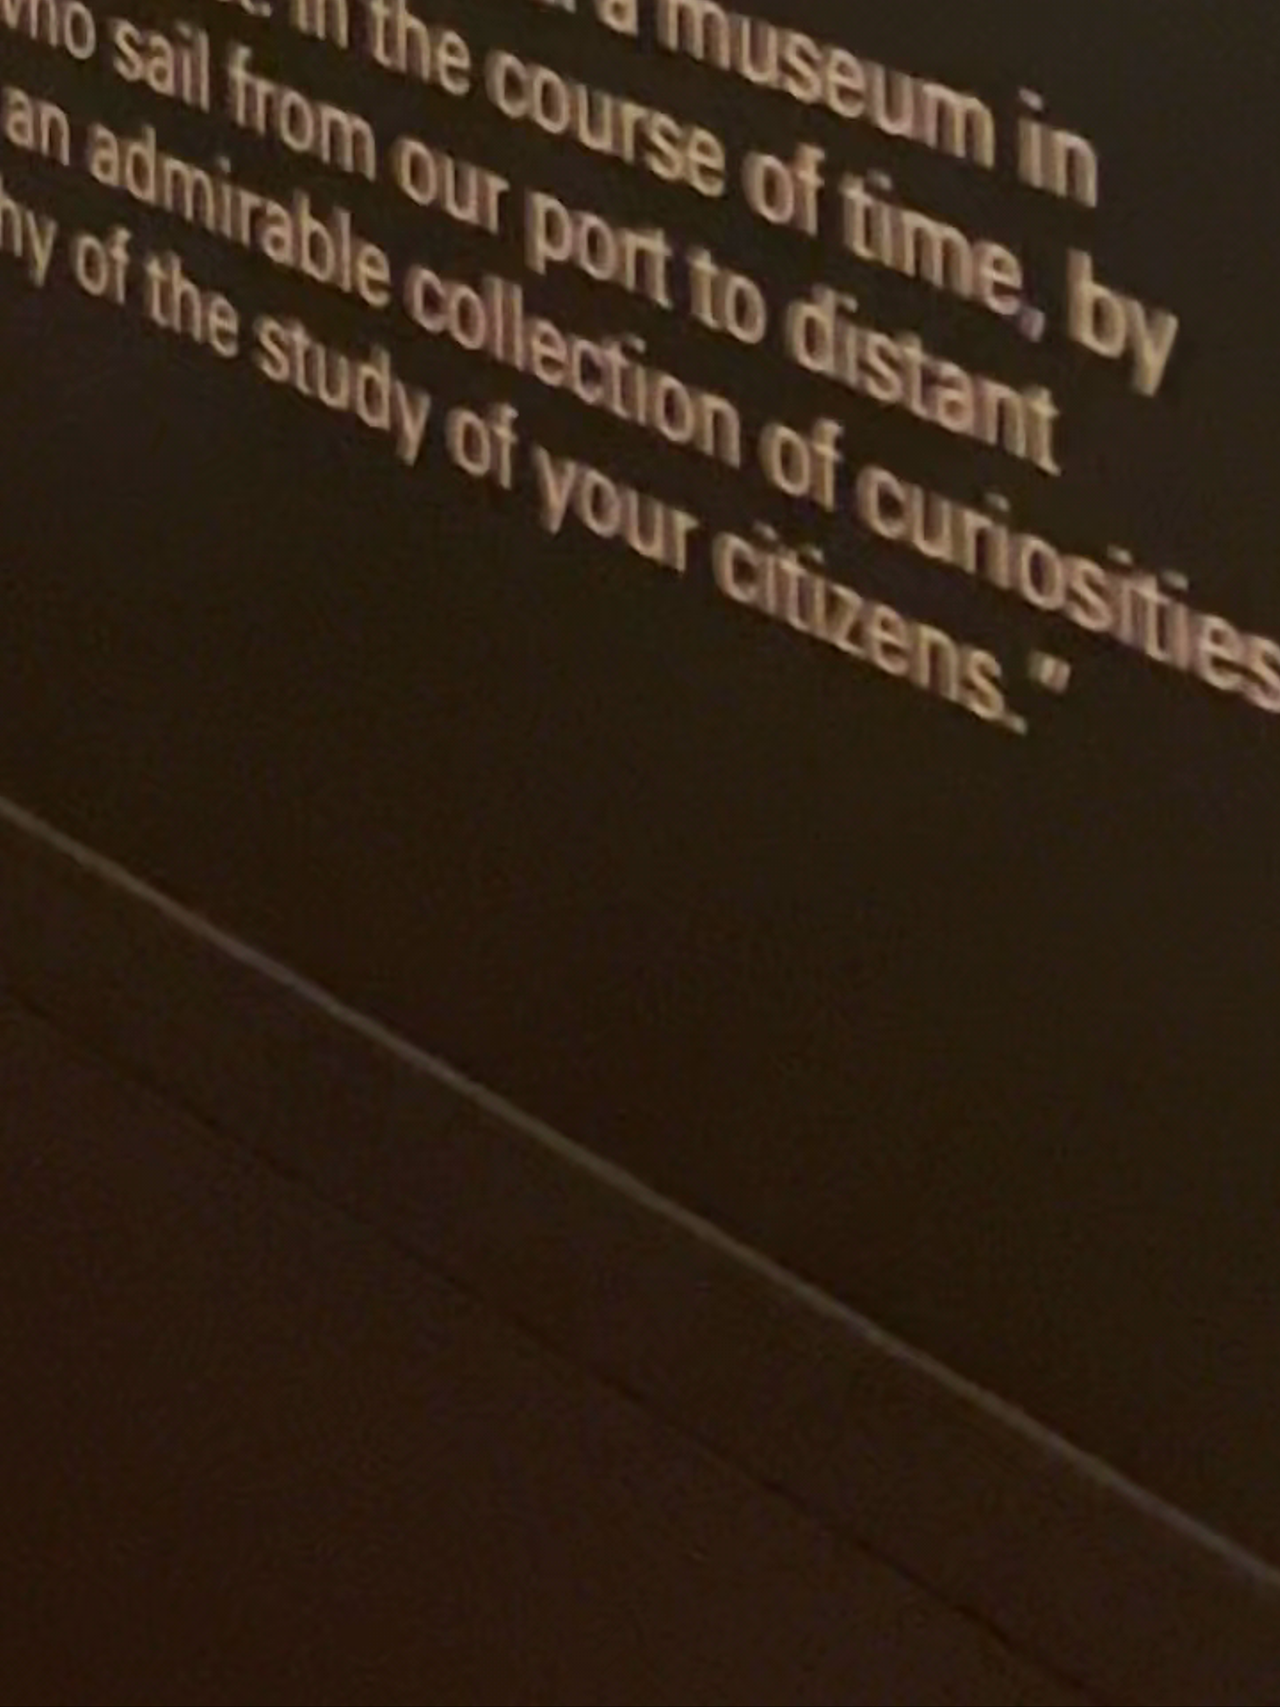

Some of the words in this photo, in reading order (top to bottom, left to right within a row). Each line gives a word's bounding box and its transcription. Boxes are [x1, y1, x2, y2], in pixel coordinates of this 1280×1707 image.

[2, 84, 69, 166] an
[86, 119, 391, 308] admirable
[404, 262, 741, 470] collection
[759, 414, 845, 512] of
[111, 12, 209, 114] sail
[225, 38, 376, 181] from
[391, 133, 509, 236] our
[526, 186, 673, 311] port
[686, 244, 768, 346] to
[785, 281, 1061, 478] distant
[486, 48, 726, 199] course
[742, 141, 825, 238] of
[838, 169, 1045, 342] time,
[1068, 246, 1179, 398] by
[1018, 86, 1098, 209] in
[71, 224, 131, 305] of
[142, 248, 240, 360] the
[252, 311, 431, 469] study
[445, 402, 519, 491] of
[531, 441, 700, 575] your
